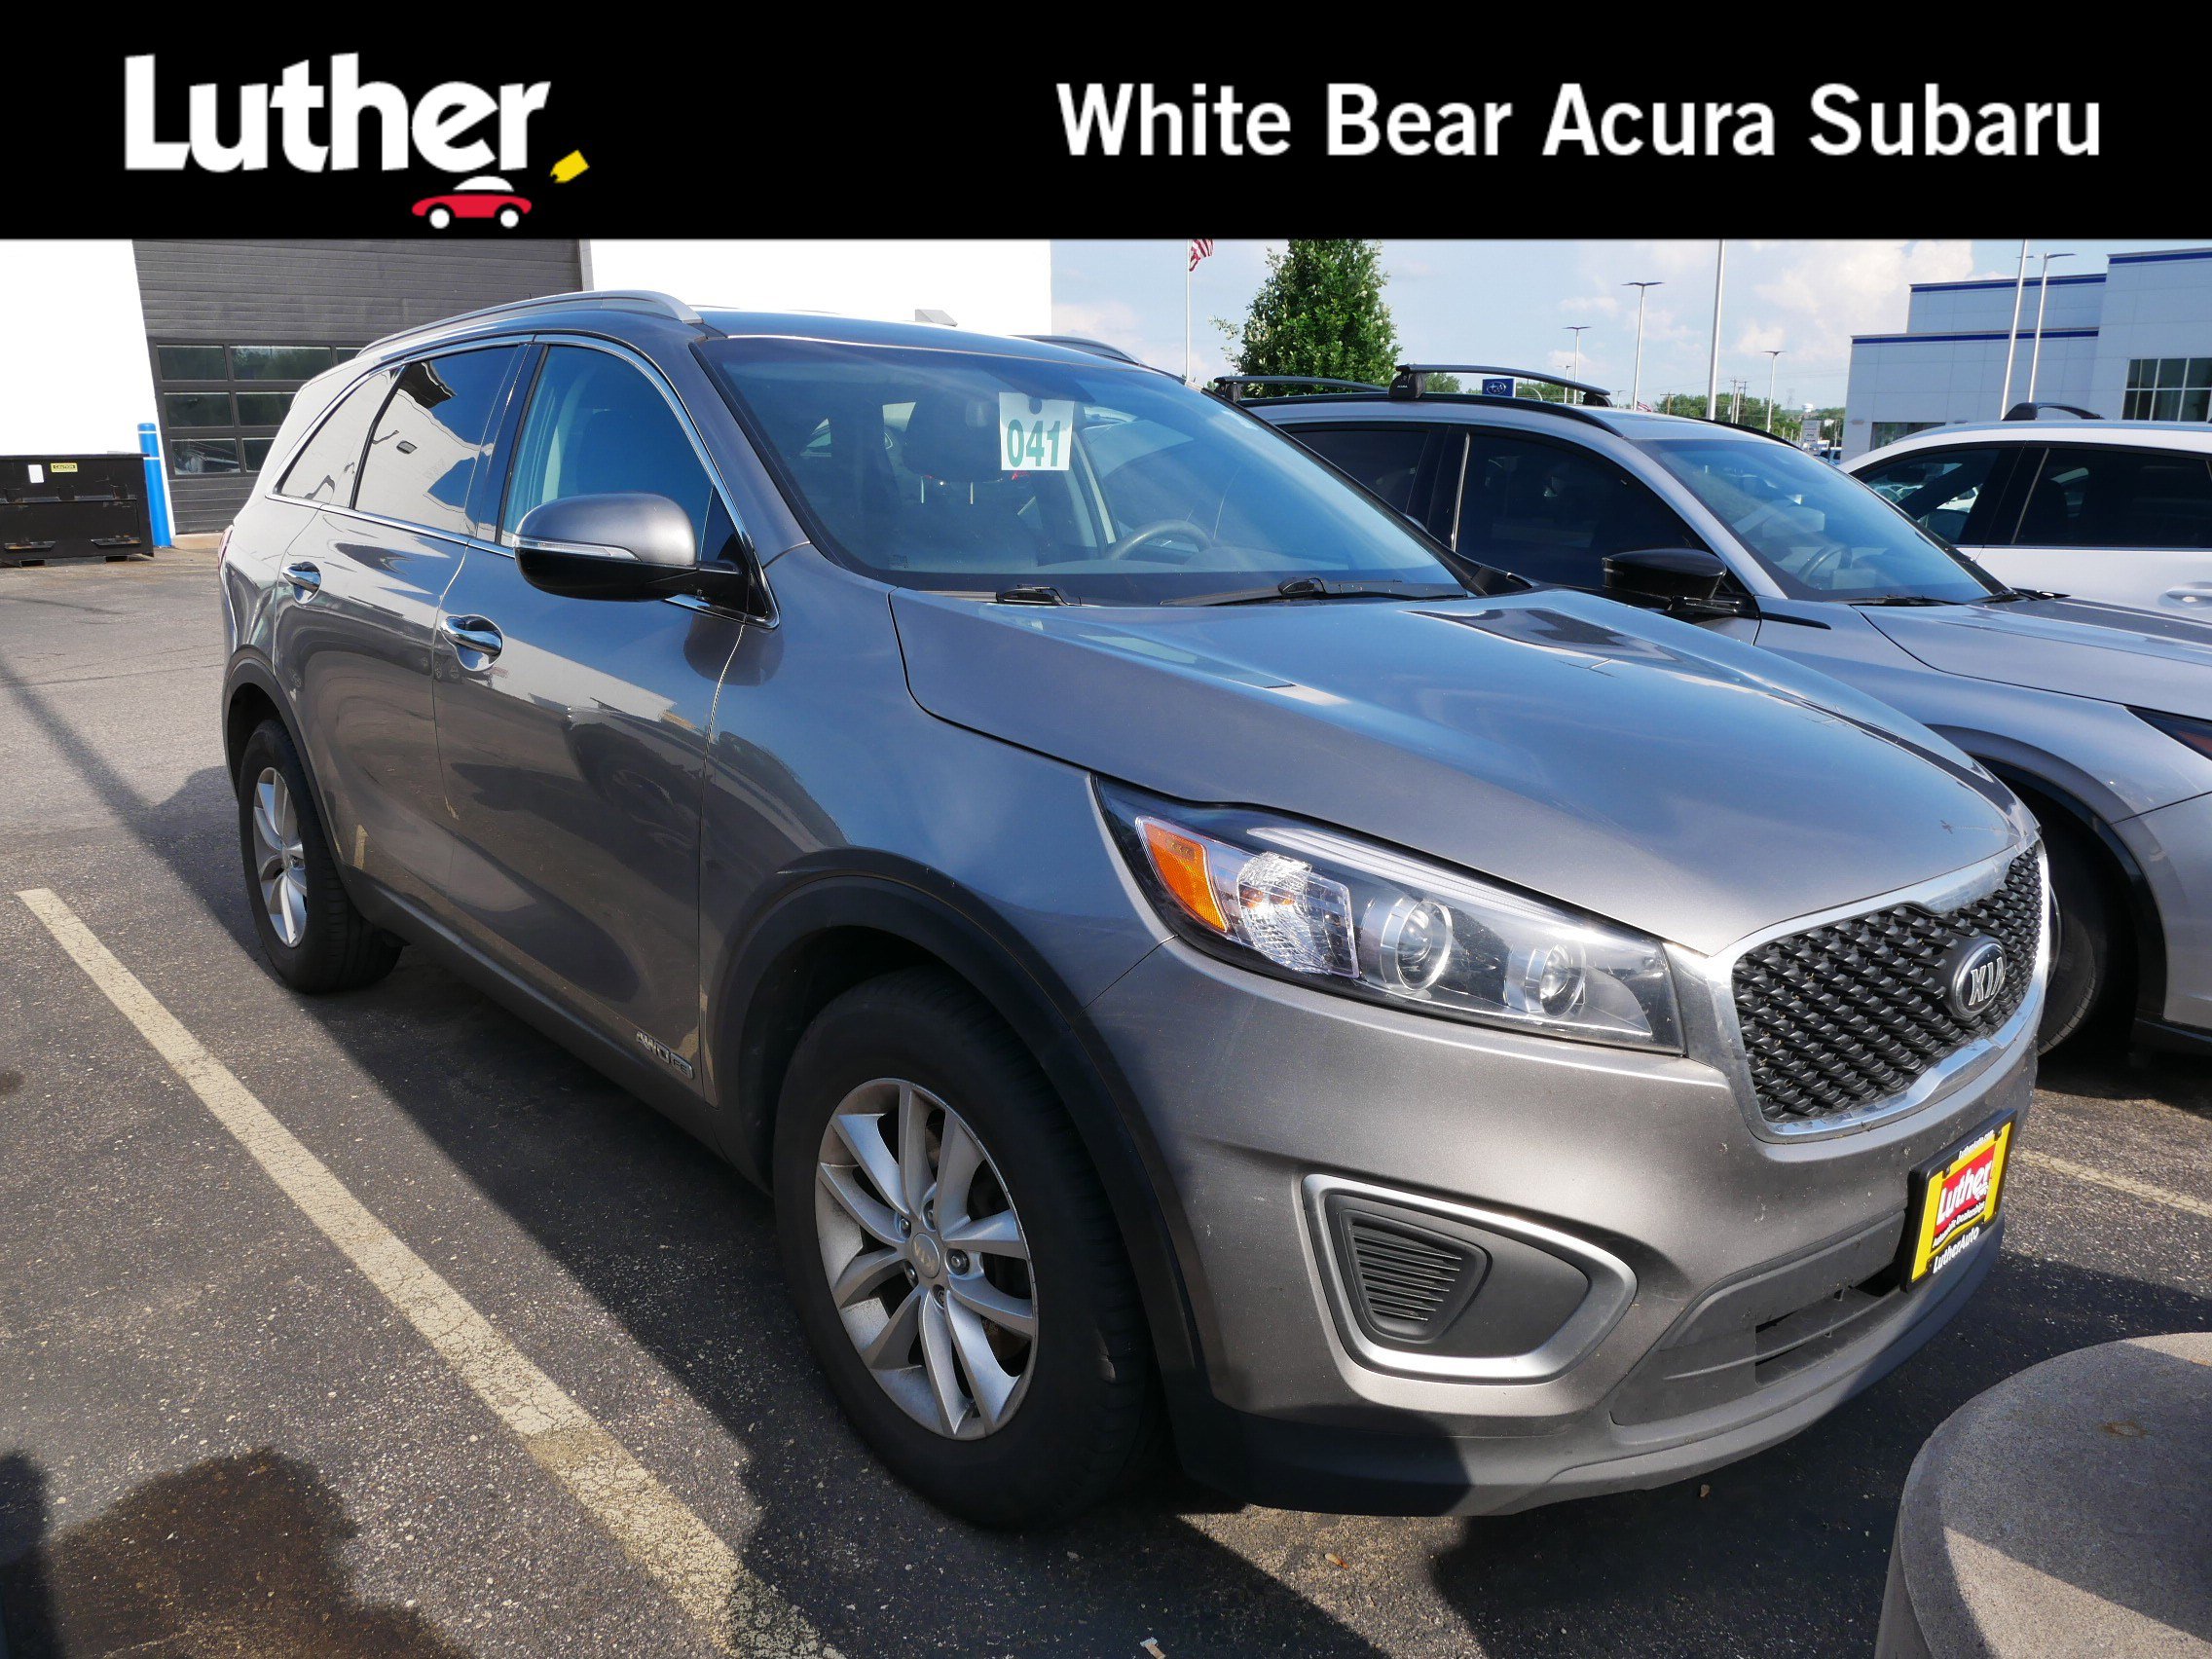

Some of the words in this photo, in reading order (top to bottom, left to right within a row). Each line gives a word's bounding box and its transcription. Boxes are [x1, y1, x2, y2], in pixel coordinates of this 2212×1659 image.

[1007, 419, 1061, 467] 041
[1969, 957, 2004, 1006] KIA
[1936, 1161, 1993, 1226] Luther
[1933, 1227, 1980, 1274] LutherAuto
